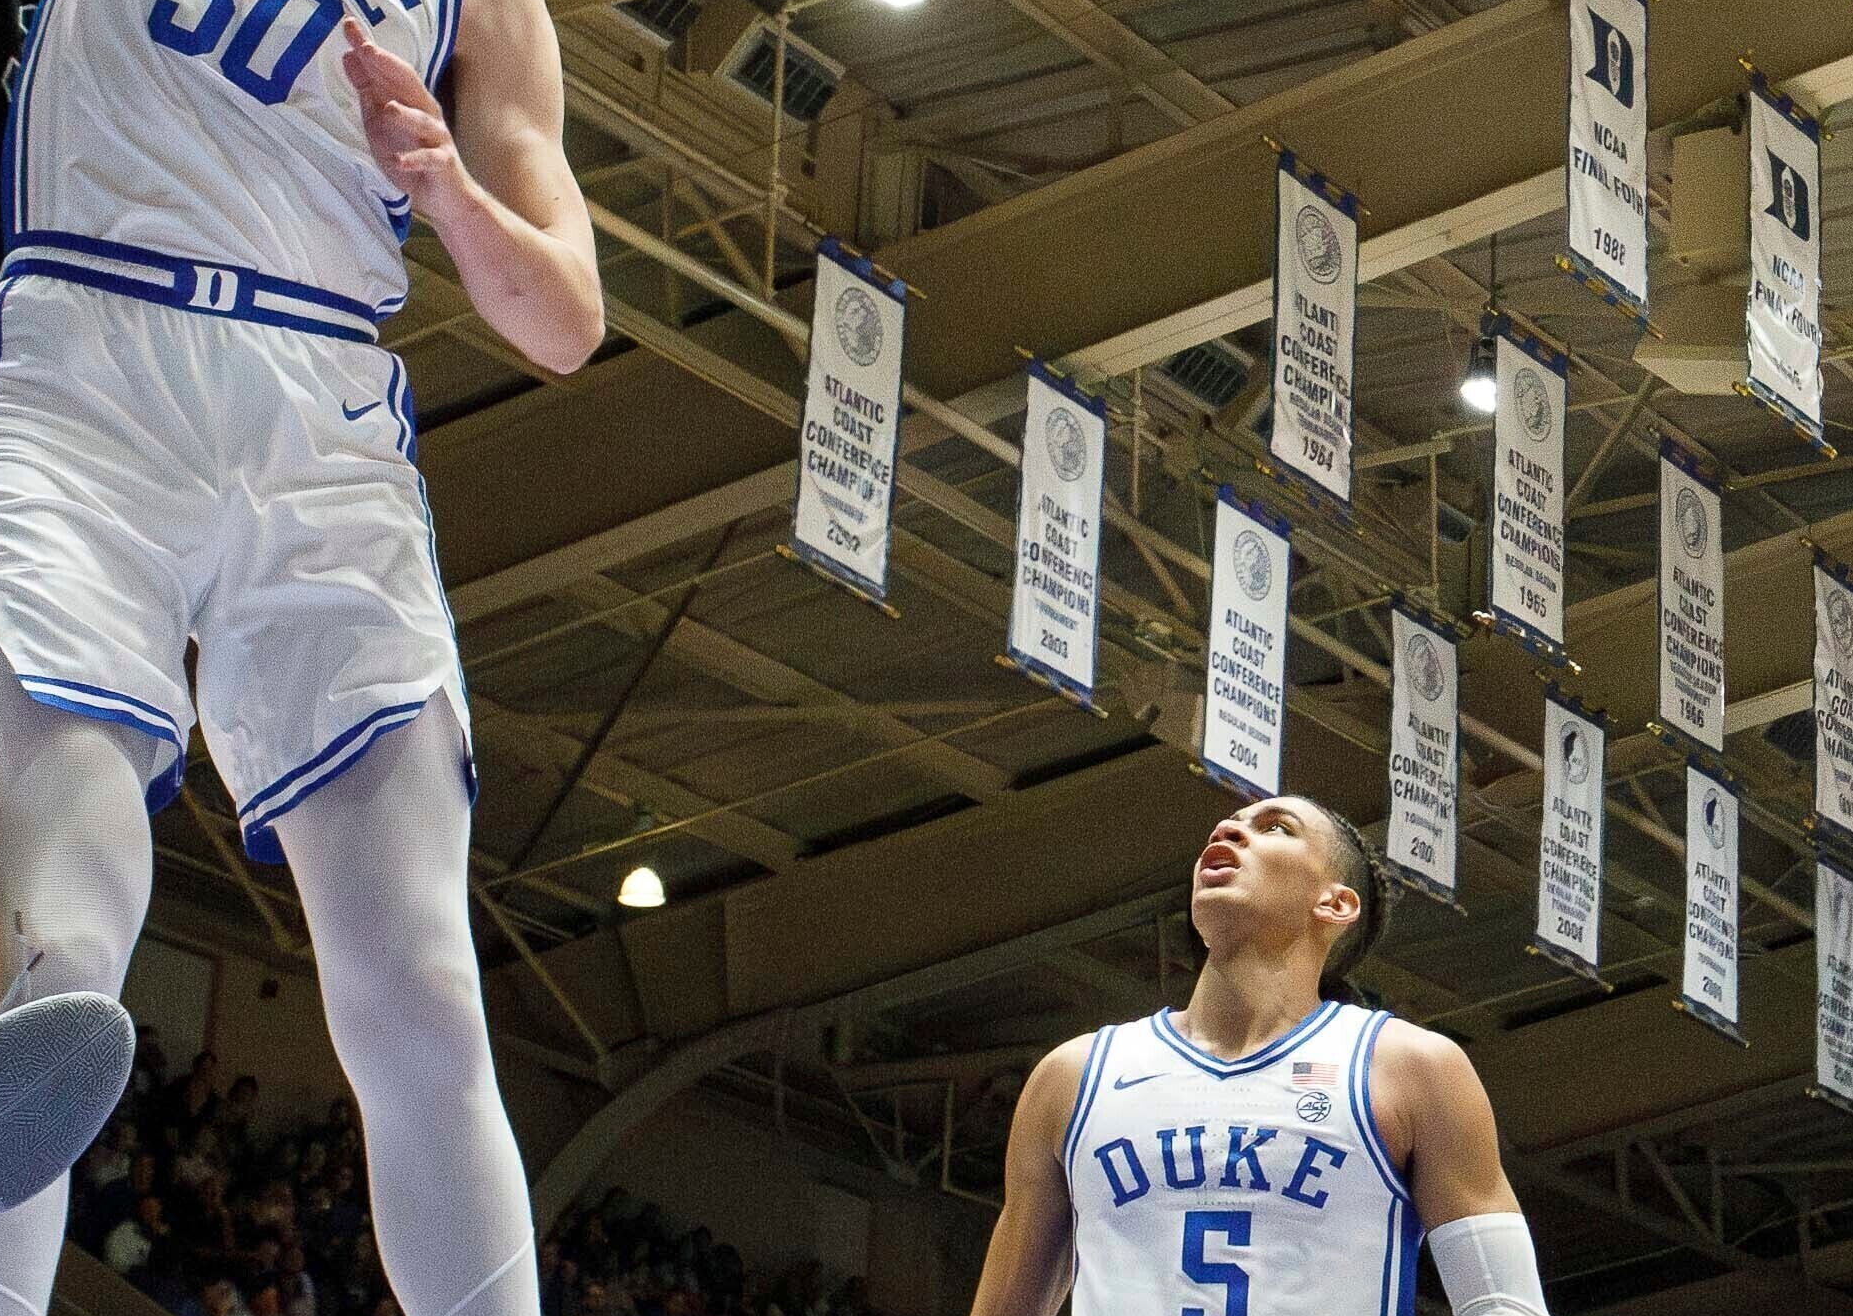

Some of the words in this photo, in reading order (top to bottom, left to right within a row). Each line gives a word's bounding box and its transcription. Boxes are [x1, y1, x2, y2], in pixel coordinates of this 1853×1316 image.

[825, 374, 884, 424] ATLANTIC
[833, 406, 874, 444] COAST
[1302, 436, 1334, 471] 1964
[1516, 479, 1546, 512] COAST
[1520, 586, 1547, 617] 1965
[1225, 608, 1273, 651] ATLANTIC
[1232, 636, 1265, 670] COAST
[1212, 651, 1281, 704] CONFERENCE
[1214, 677, 1276, 727] CHAMPIONS
[1229, 739, 1259, 770] 2004
[1092, 1124, 1349, 1210] DUKE
